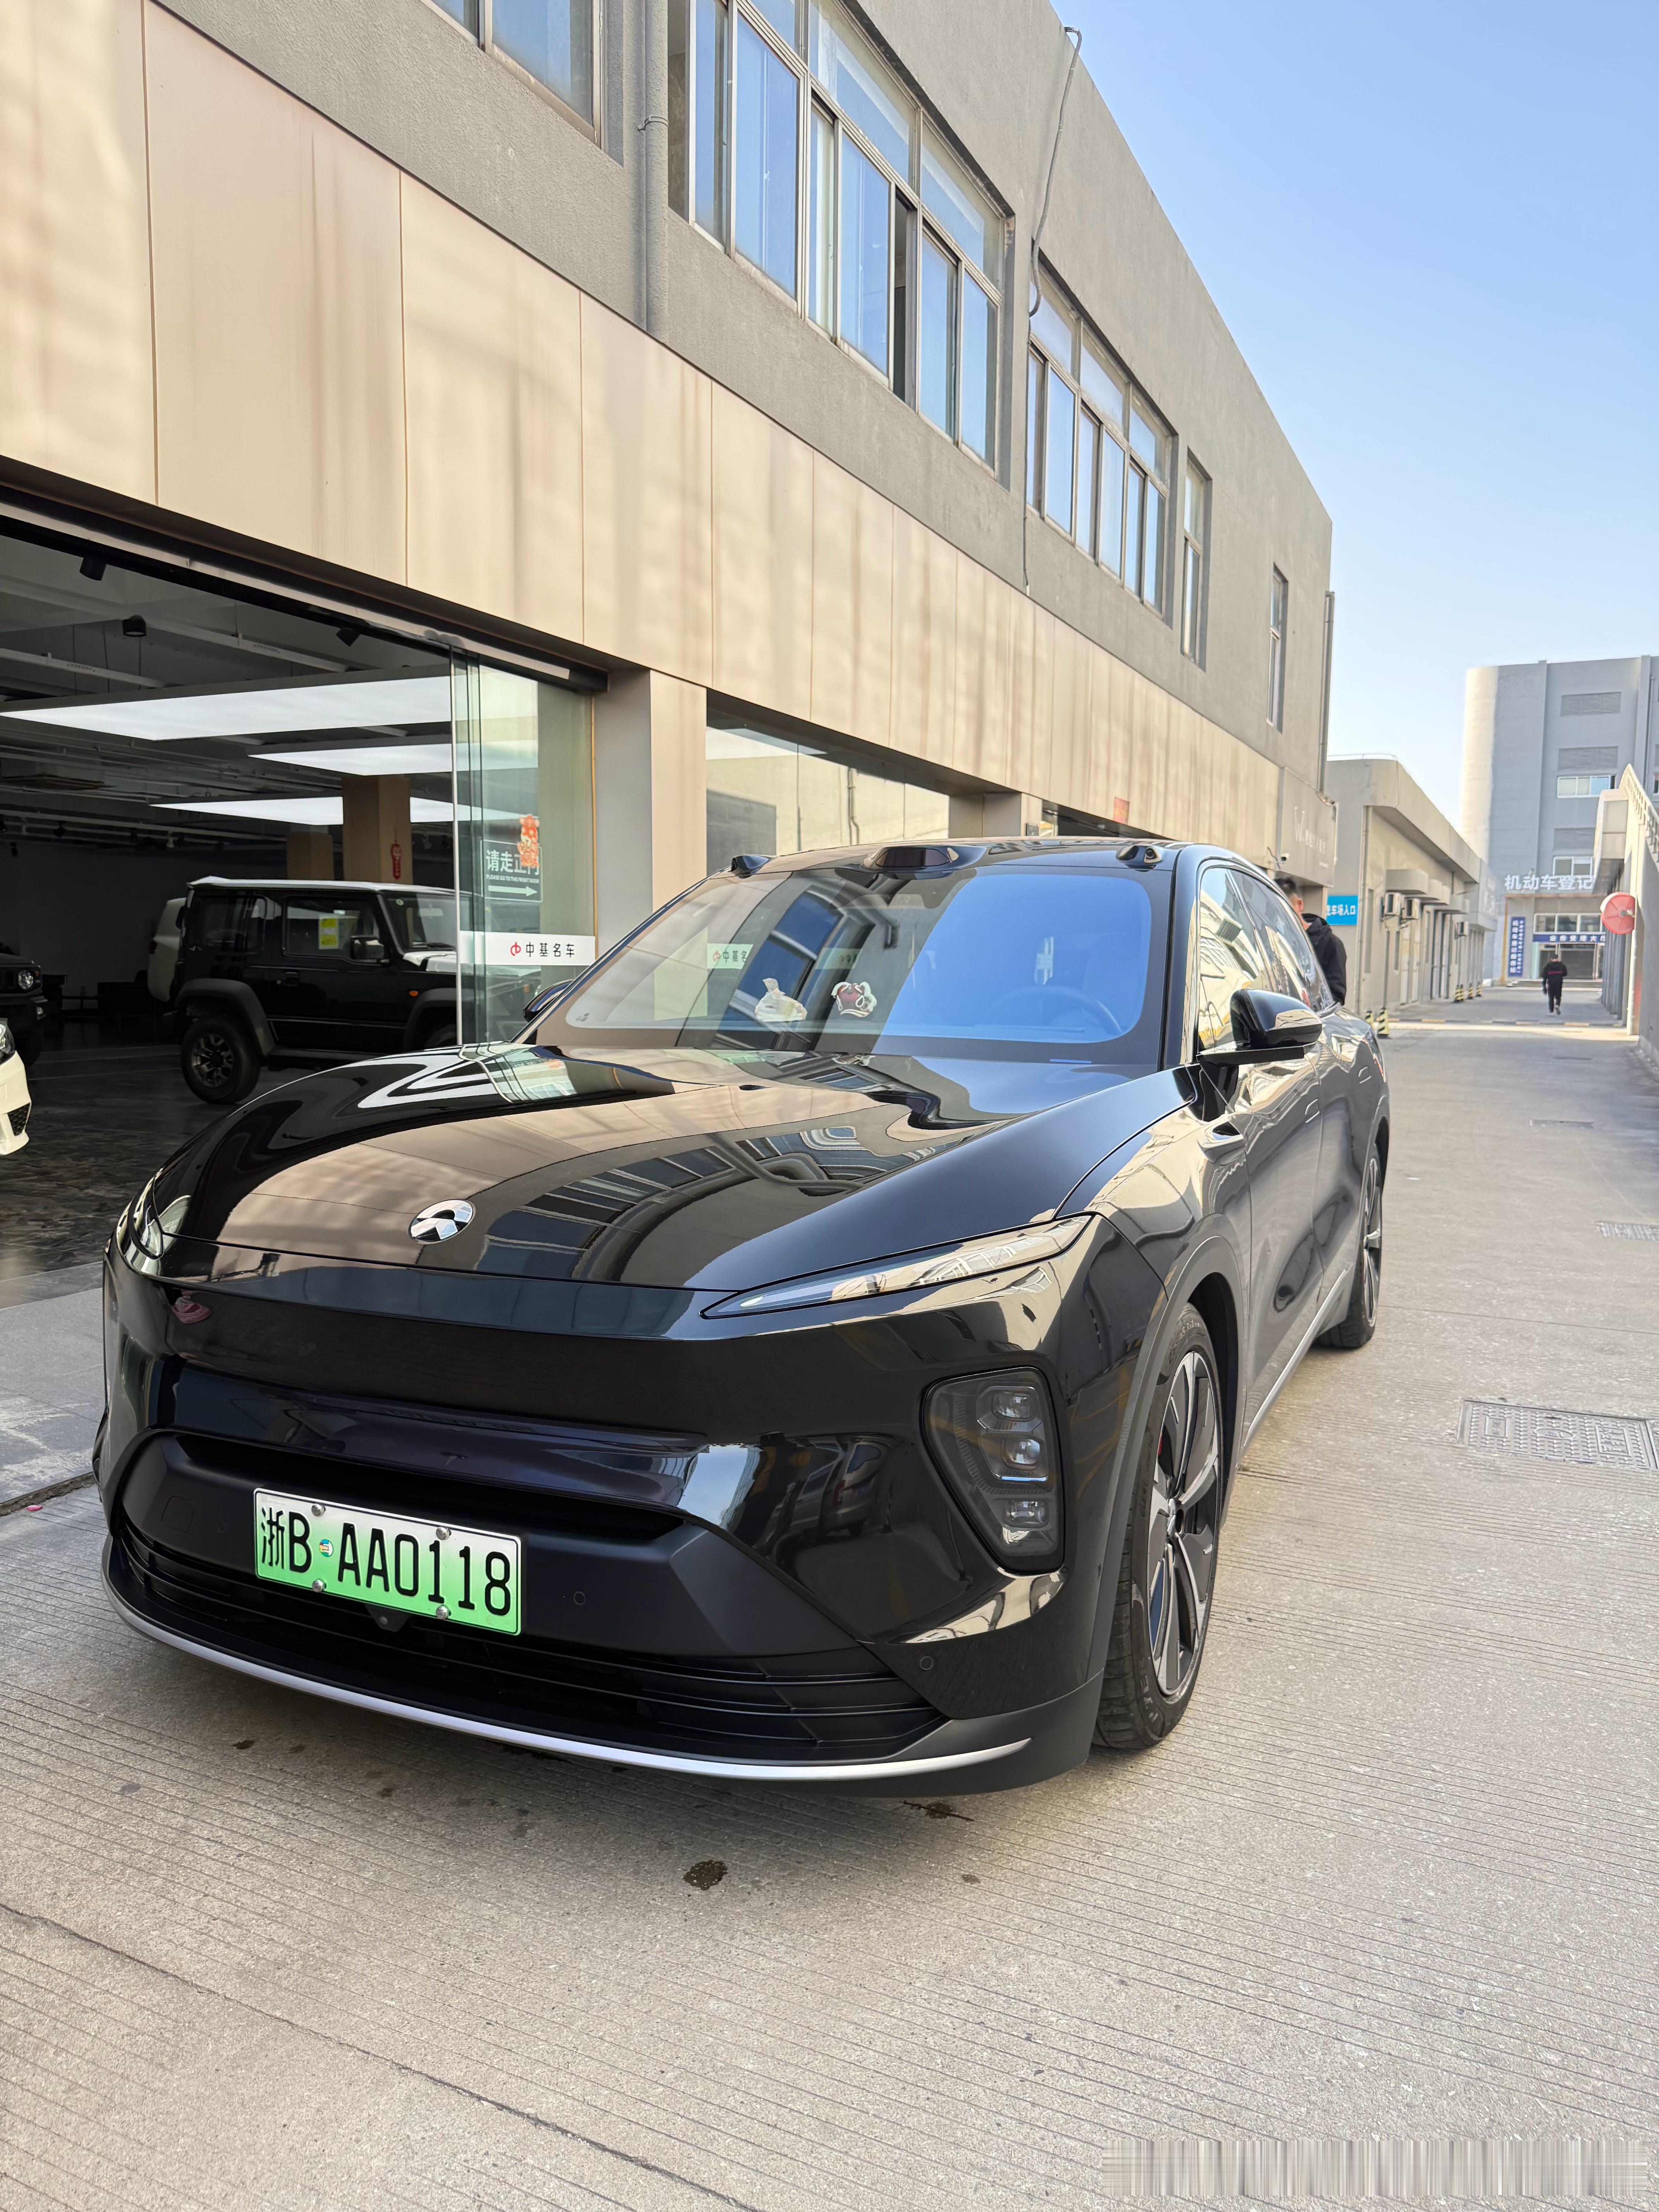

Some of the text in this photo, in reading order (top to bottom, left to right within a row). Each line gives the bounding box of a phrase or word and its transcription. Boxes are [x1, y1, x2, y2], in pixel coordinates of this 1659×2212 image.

[1504, 874, 1594, 890] 机动车登记
[526, 942, 575, 957] 中基名车
[338, 1522, 510, 1616] AA0118
